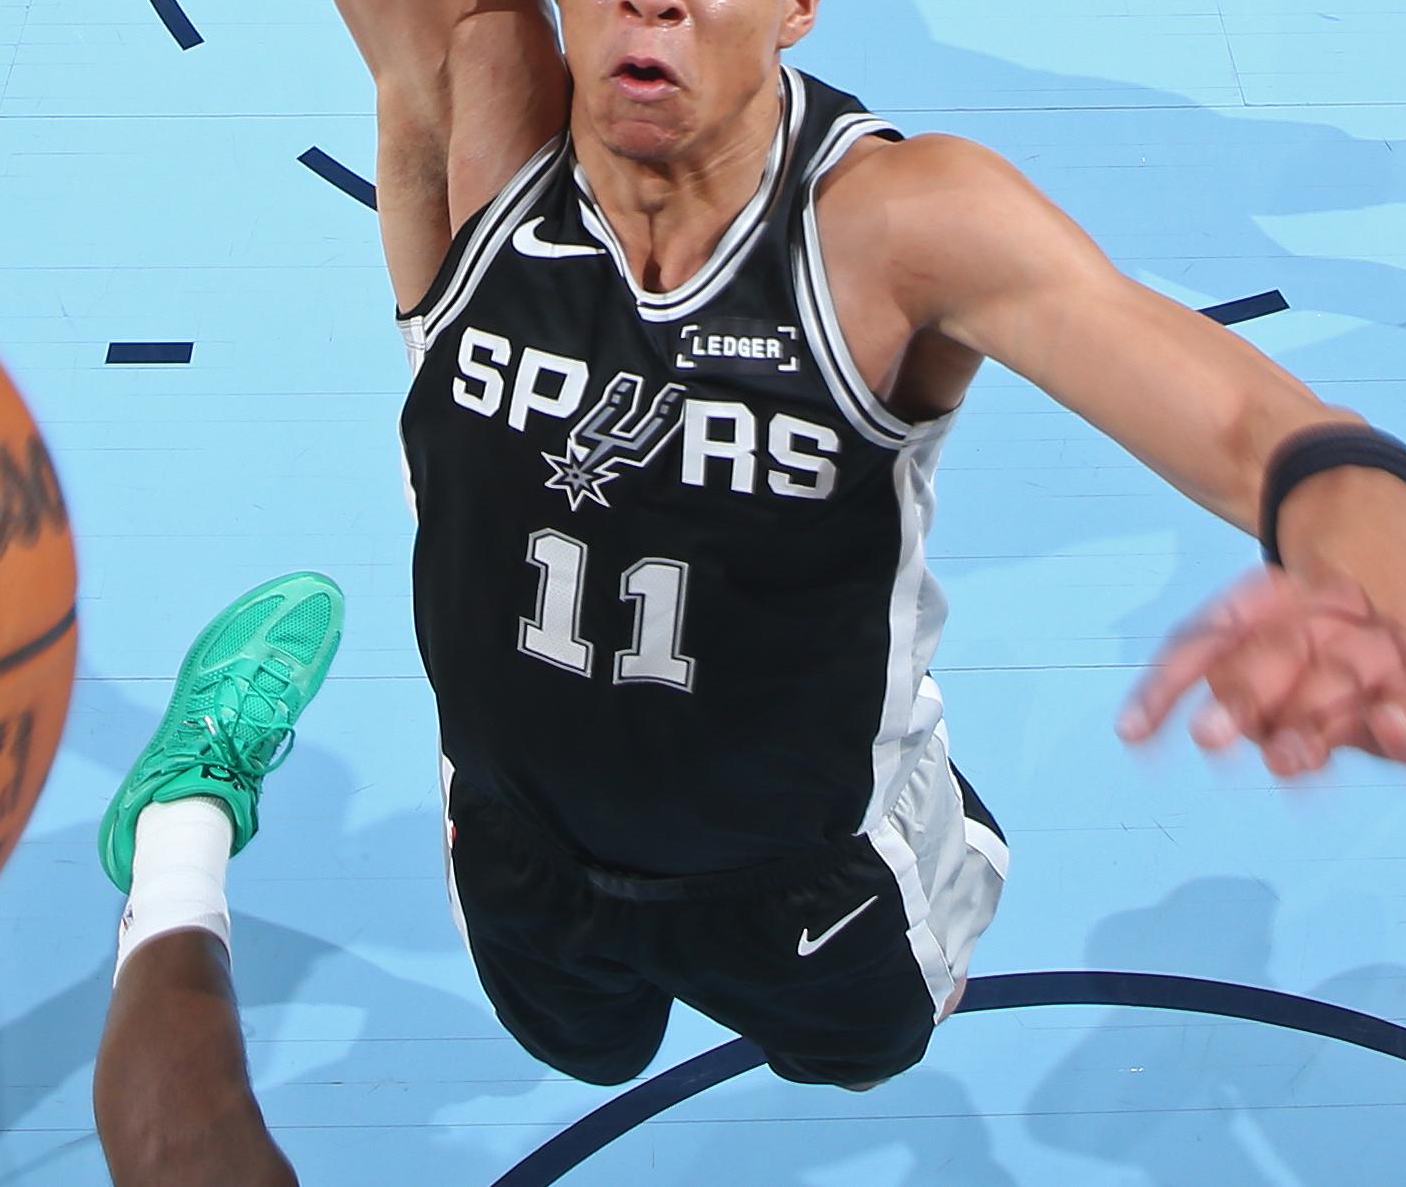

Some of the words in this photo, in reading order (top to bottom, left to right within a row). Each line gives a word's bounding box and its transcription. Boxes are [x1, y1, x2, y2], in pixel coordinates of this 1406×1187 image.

[452, 326, 843, 512] SPURS
[692, 335, 783, 360] LEDGER
[517, 527, 695, 694] 11
